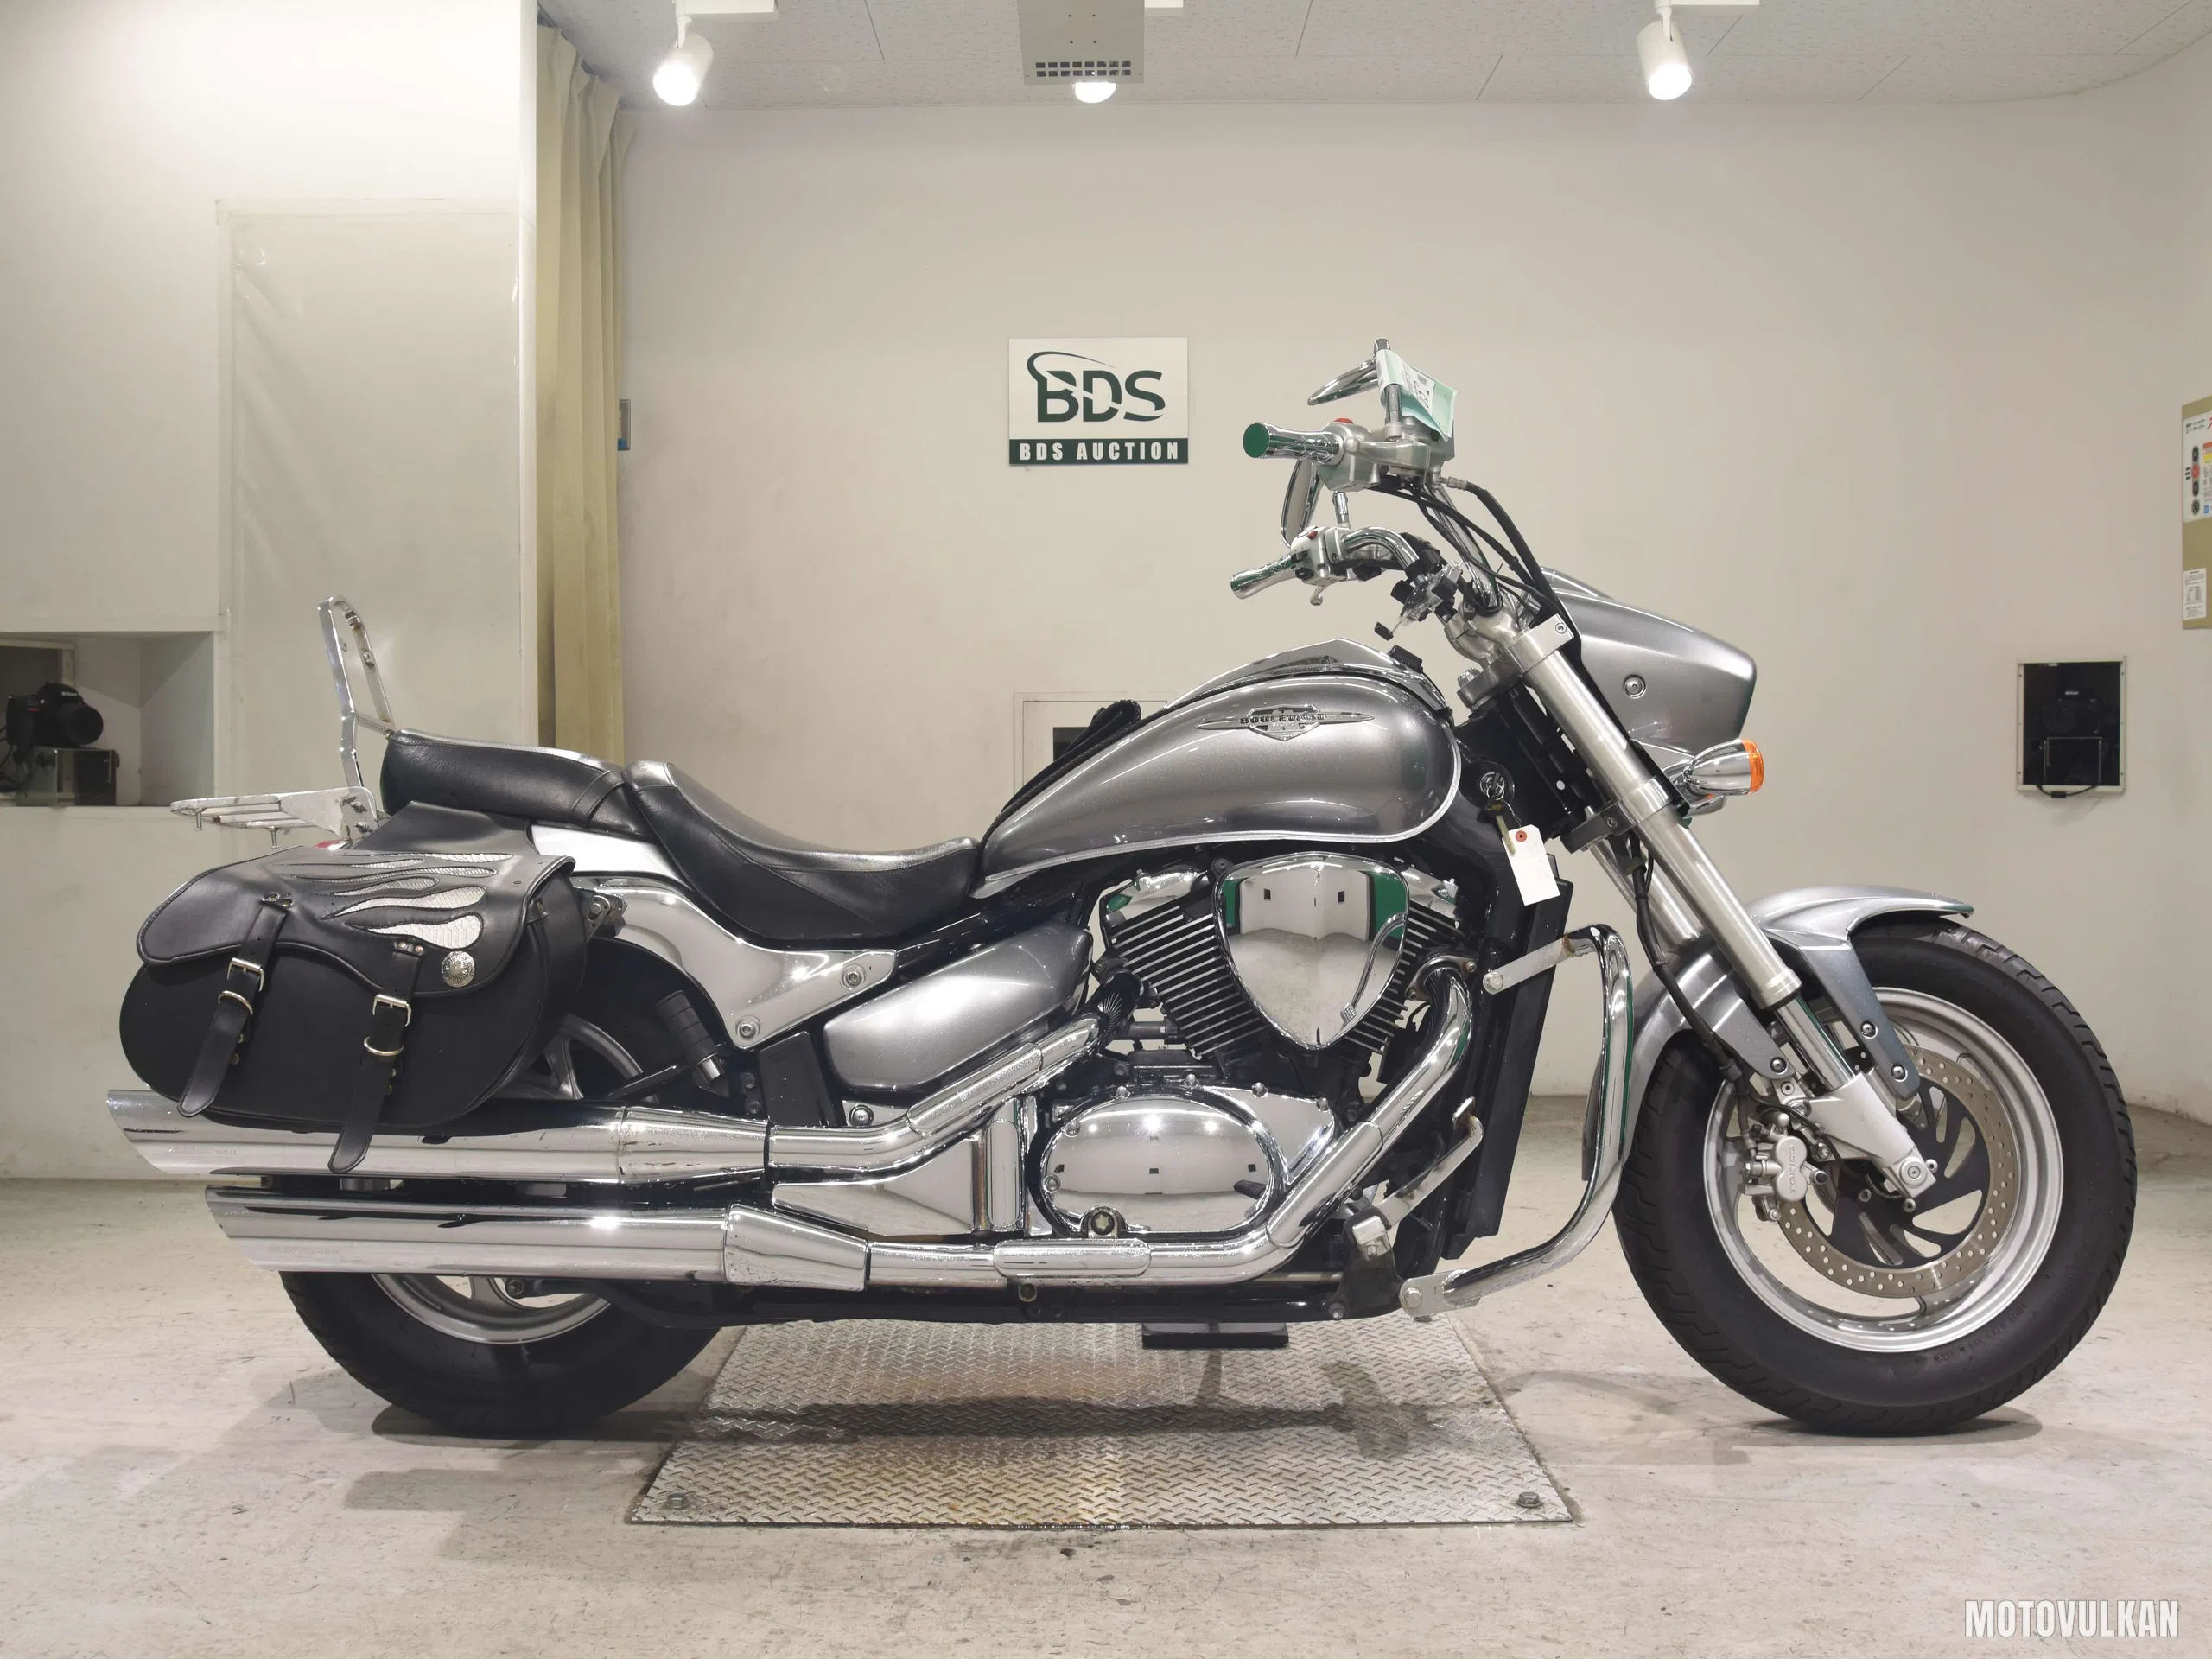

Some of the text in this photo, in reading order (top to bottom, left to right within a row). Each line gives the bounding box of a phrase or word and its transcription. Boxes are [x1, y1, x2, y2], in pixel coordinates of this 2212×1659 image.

[1027, 353, 1166, 423] BDS
[1020, 442, 1179, 461] BDS AUCTION
